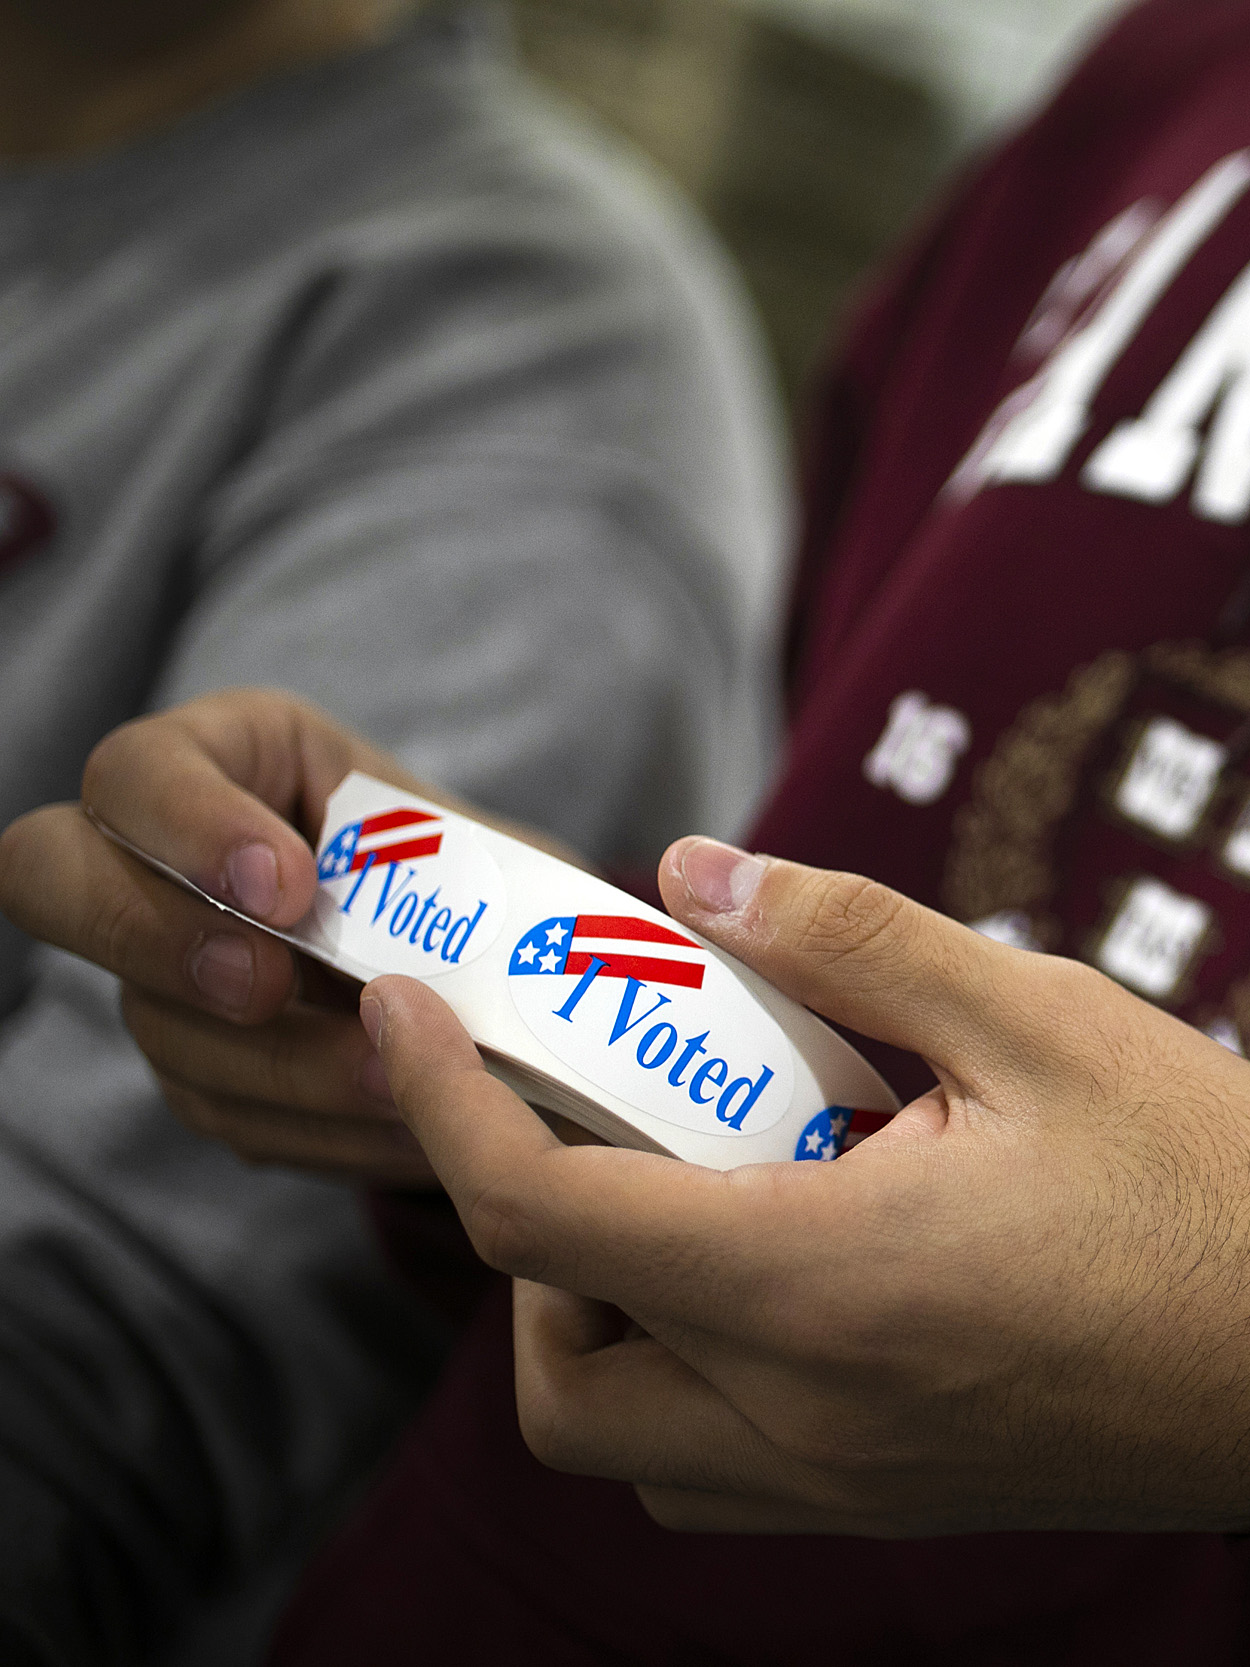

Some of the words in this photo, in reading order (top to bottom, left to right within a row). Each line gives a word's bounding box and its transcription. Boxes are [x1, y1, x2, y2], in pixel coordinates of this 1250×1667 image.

[341, 852, 376, 916] I
[372, 862, 488, 964] Voted
[551, 954, 611, 1023] I
[608, 975, 775, 1131] Voted
